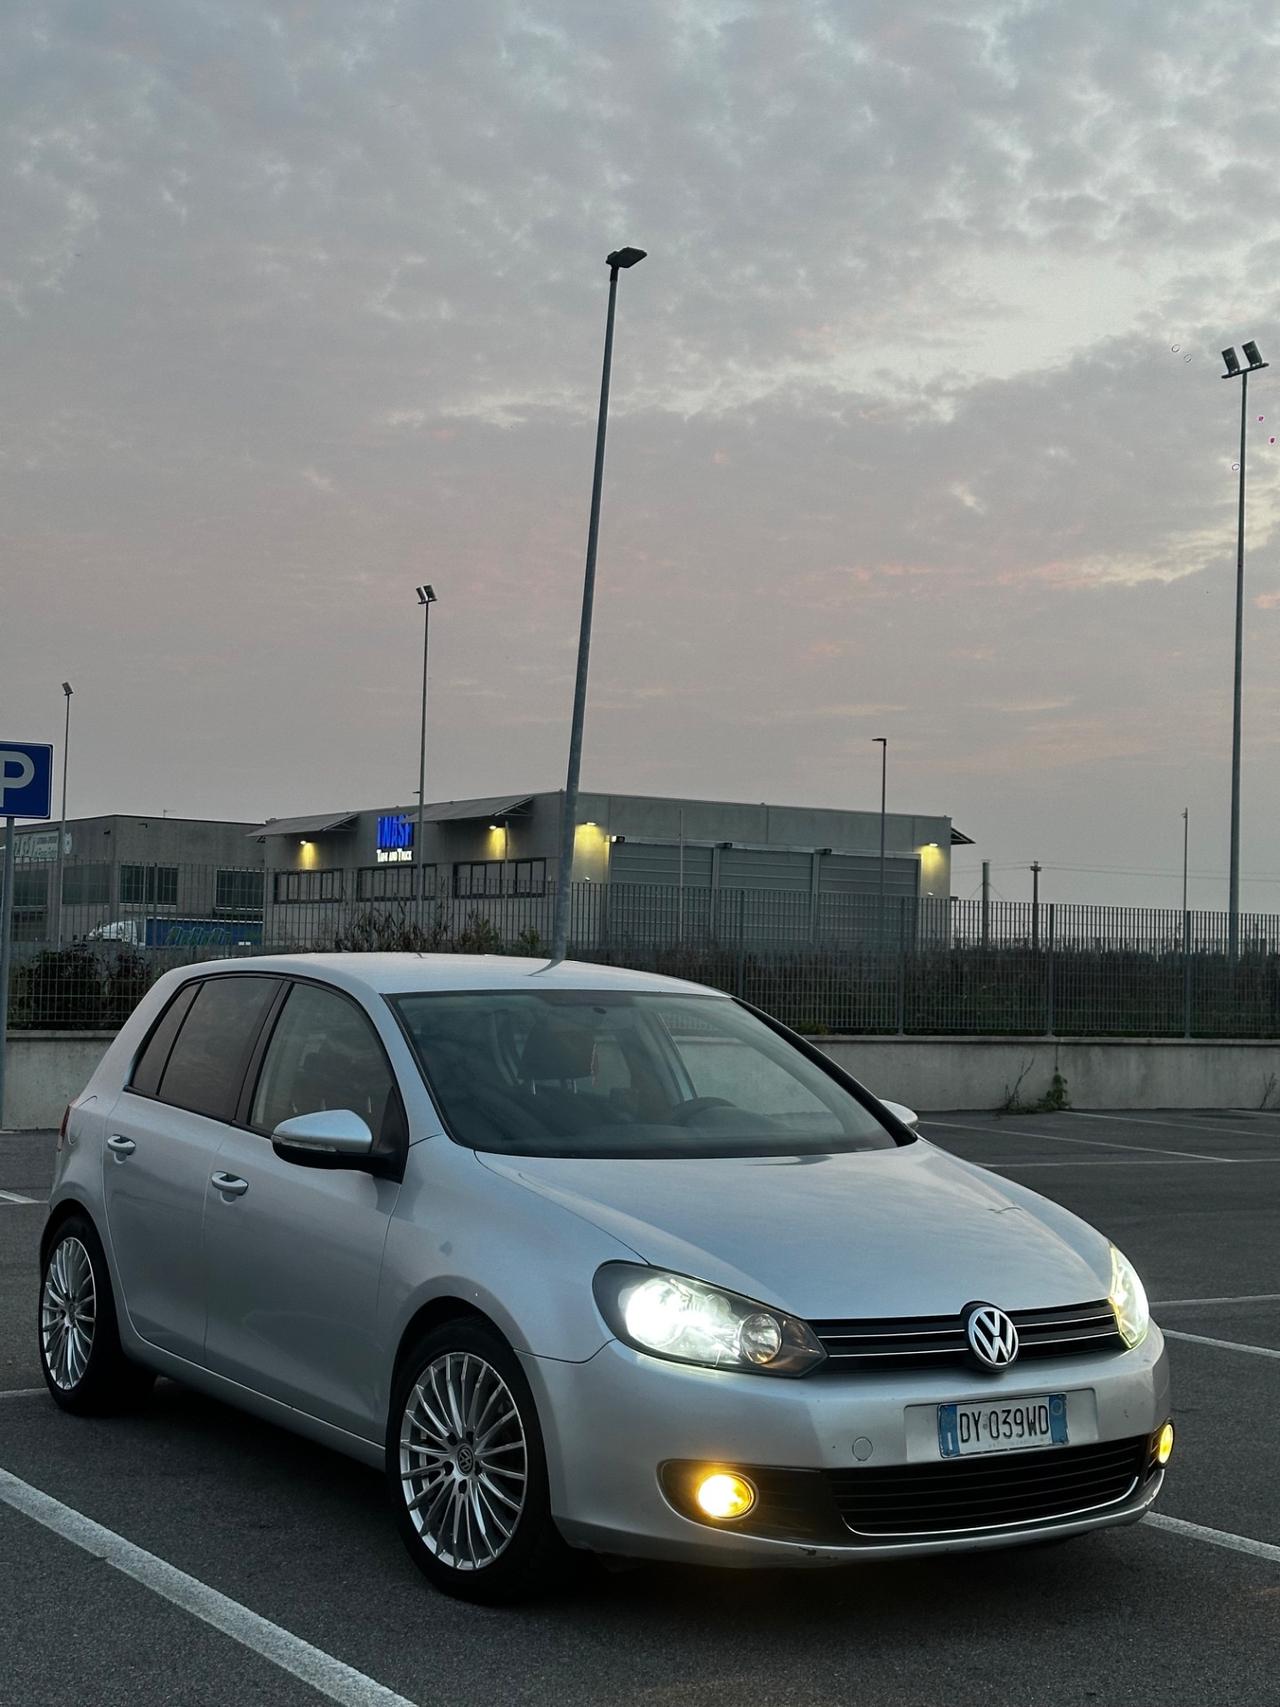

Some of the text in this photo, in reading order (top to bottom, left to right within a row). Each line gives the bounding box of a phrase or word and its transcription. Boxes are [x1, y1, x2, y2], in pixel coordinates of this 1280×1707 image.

[0, 750, 35, 808] P
[968, 1307, 1019, 1366] VW
[959, 1411, 982, 1443] DY
[988, 1405, 1050, 1440] 039WD
